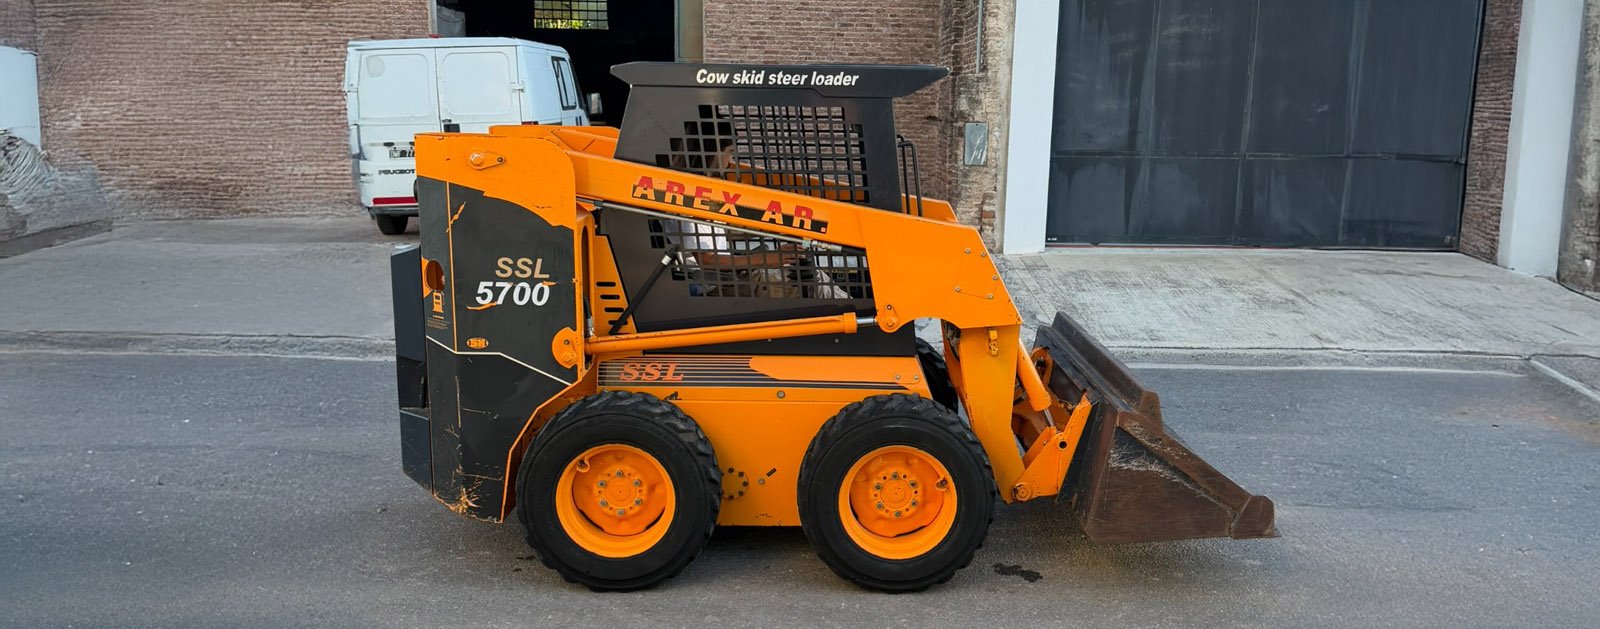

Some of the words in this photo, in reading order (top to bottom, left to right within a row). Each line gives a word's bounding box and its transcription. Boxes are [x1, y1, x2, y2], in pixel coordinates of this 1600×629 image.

[696, 68, 729, 84] Cow
[733, 70, 765, 85] skid
[768, 70, 808, 85] steer
[811, 71, 859, 86] loader
[633, 175, 742, 216] AREX
[761, 200, 827, 233] AR.
[495, 257, 550, 278] SSL
[475, 281, 550, 306] 5700
[620, 362, 684, 382] SSL
